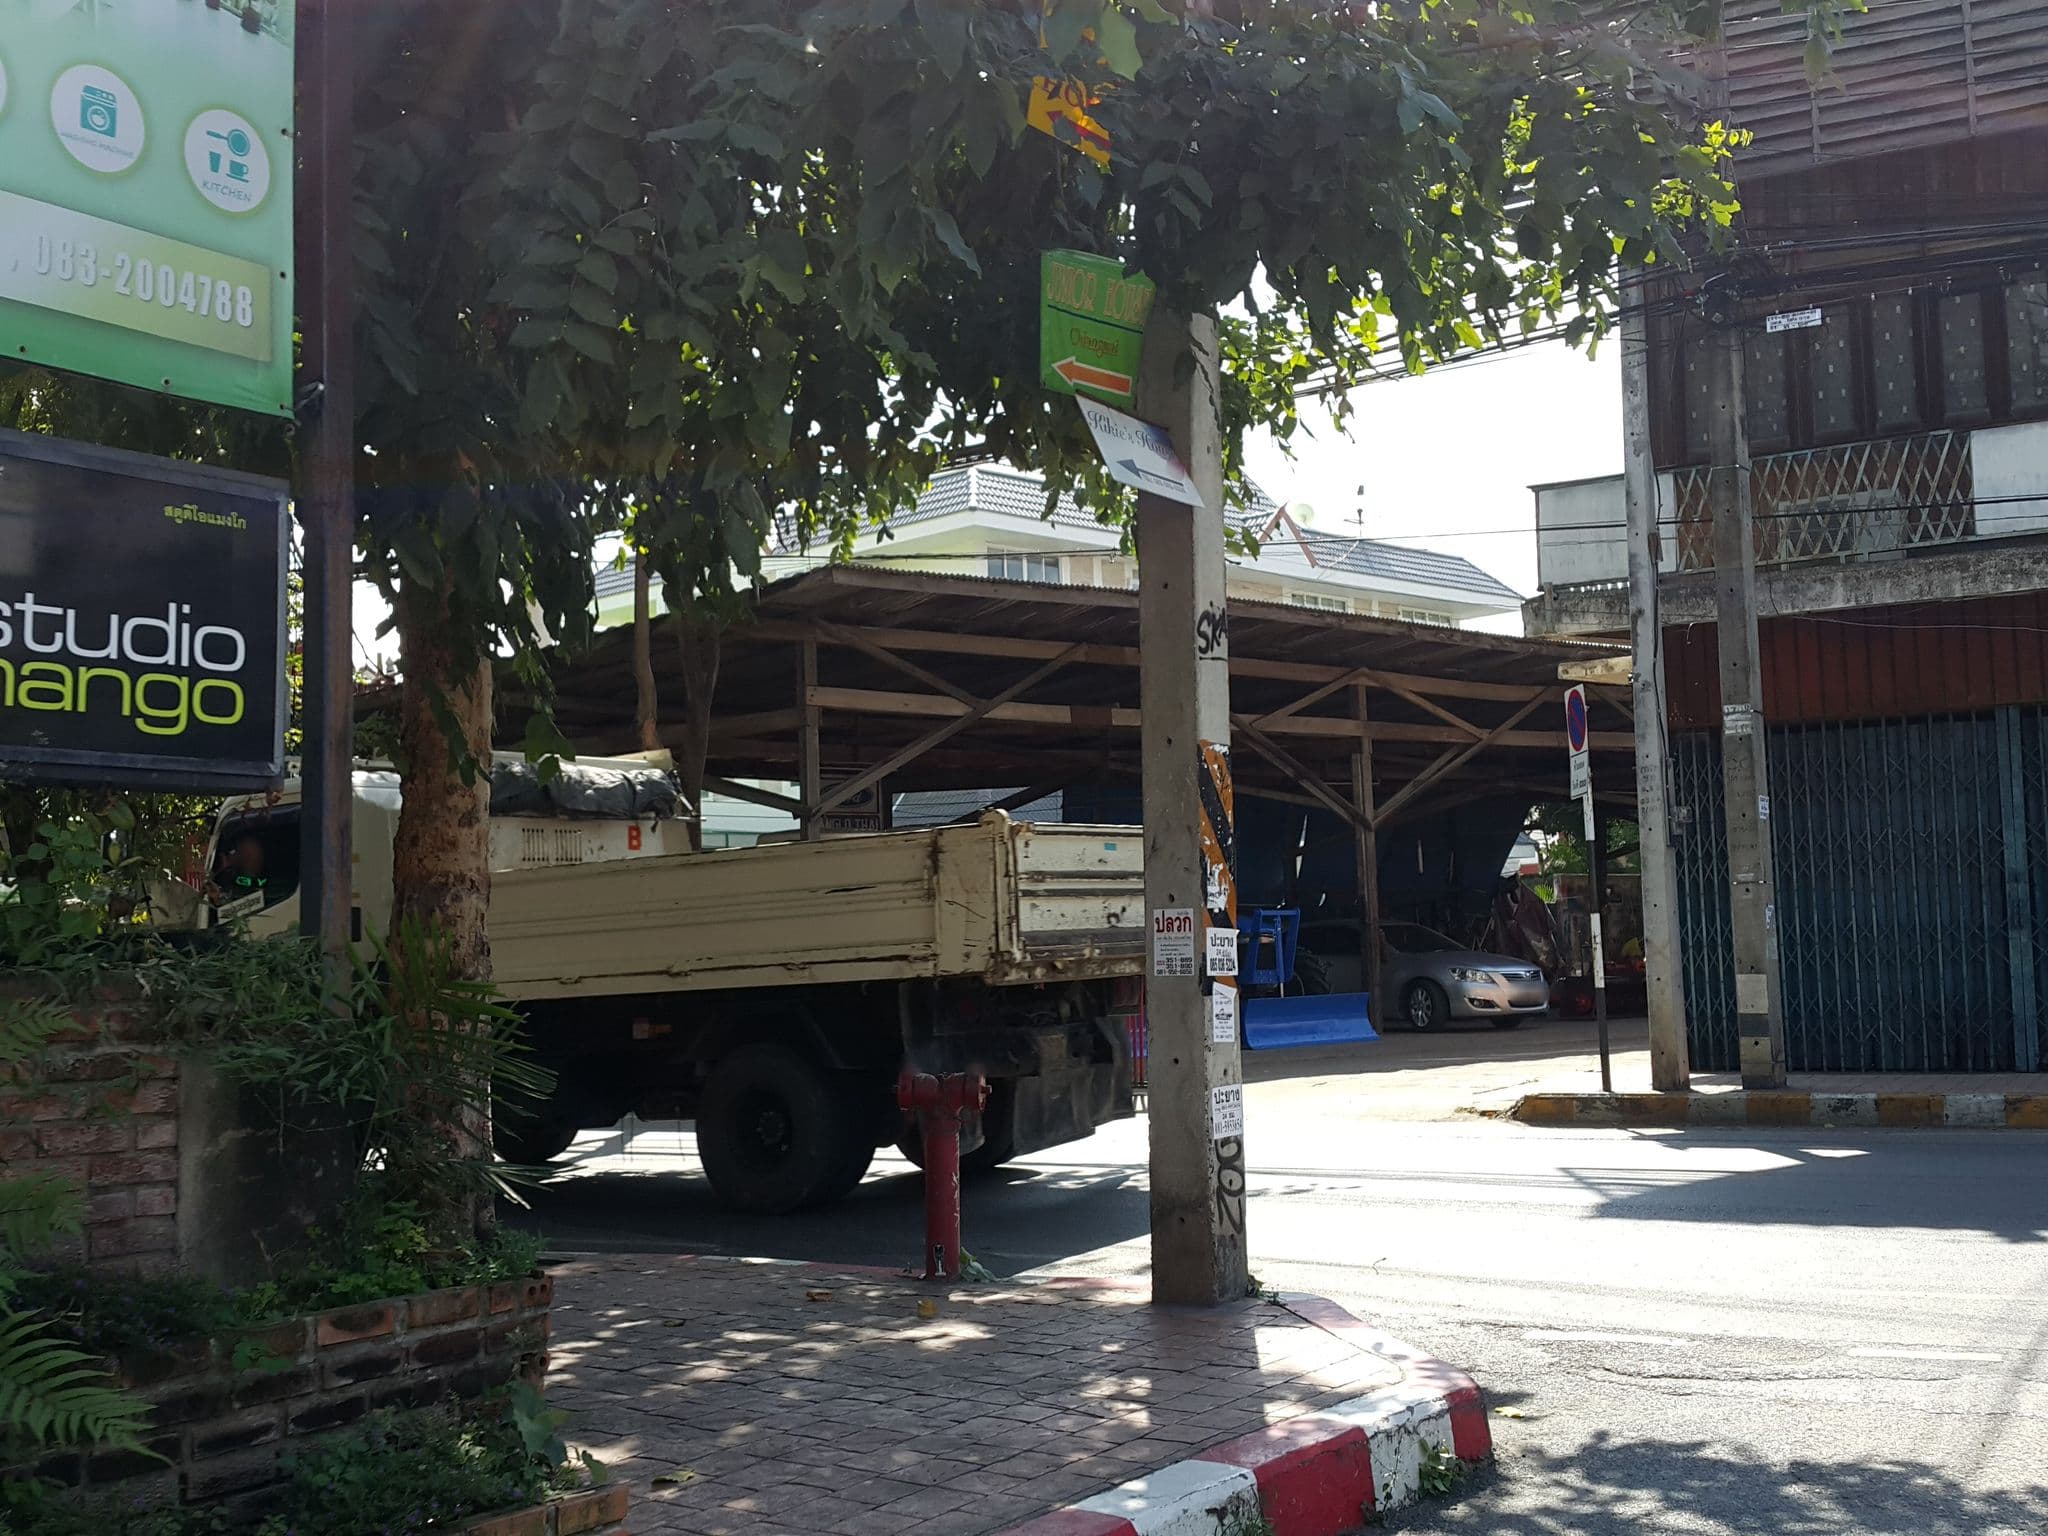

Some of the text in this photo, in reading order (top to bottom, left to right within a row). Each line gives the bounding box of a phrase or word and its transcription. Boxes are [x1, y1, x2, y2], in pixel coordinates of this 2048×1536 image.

[203, 179, 252, 202] KITCHEN
[33, 231, 254, 328] 083-2004788
[0, 657, 245, 736] ango
[628, 825, 641, 850] B
[1155, 910, 1192, 933] ปลวก
[1210, 933, 1234, 948] ปะยาง
[1214, 1089, 1240, 1105] ปะยาง
